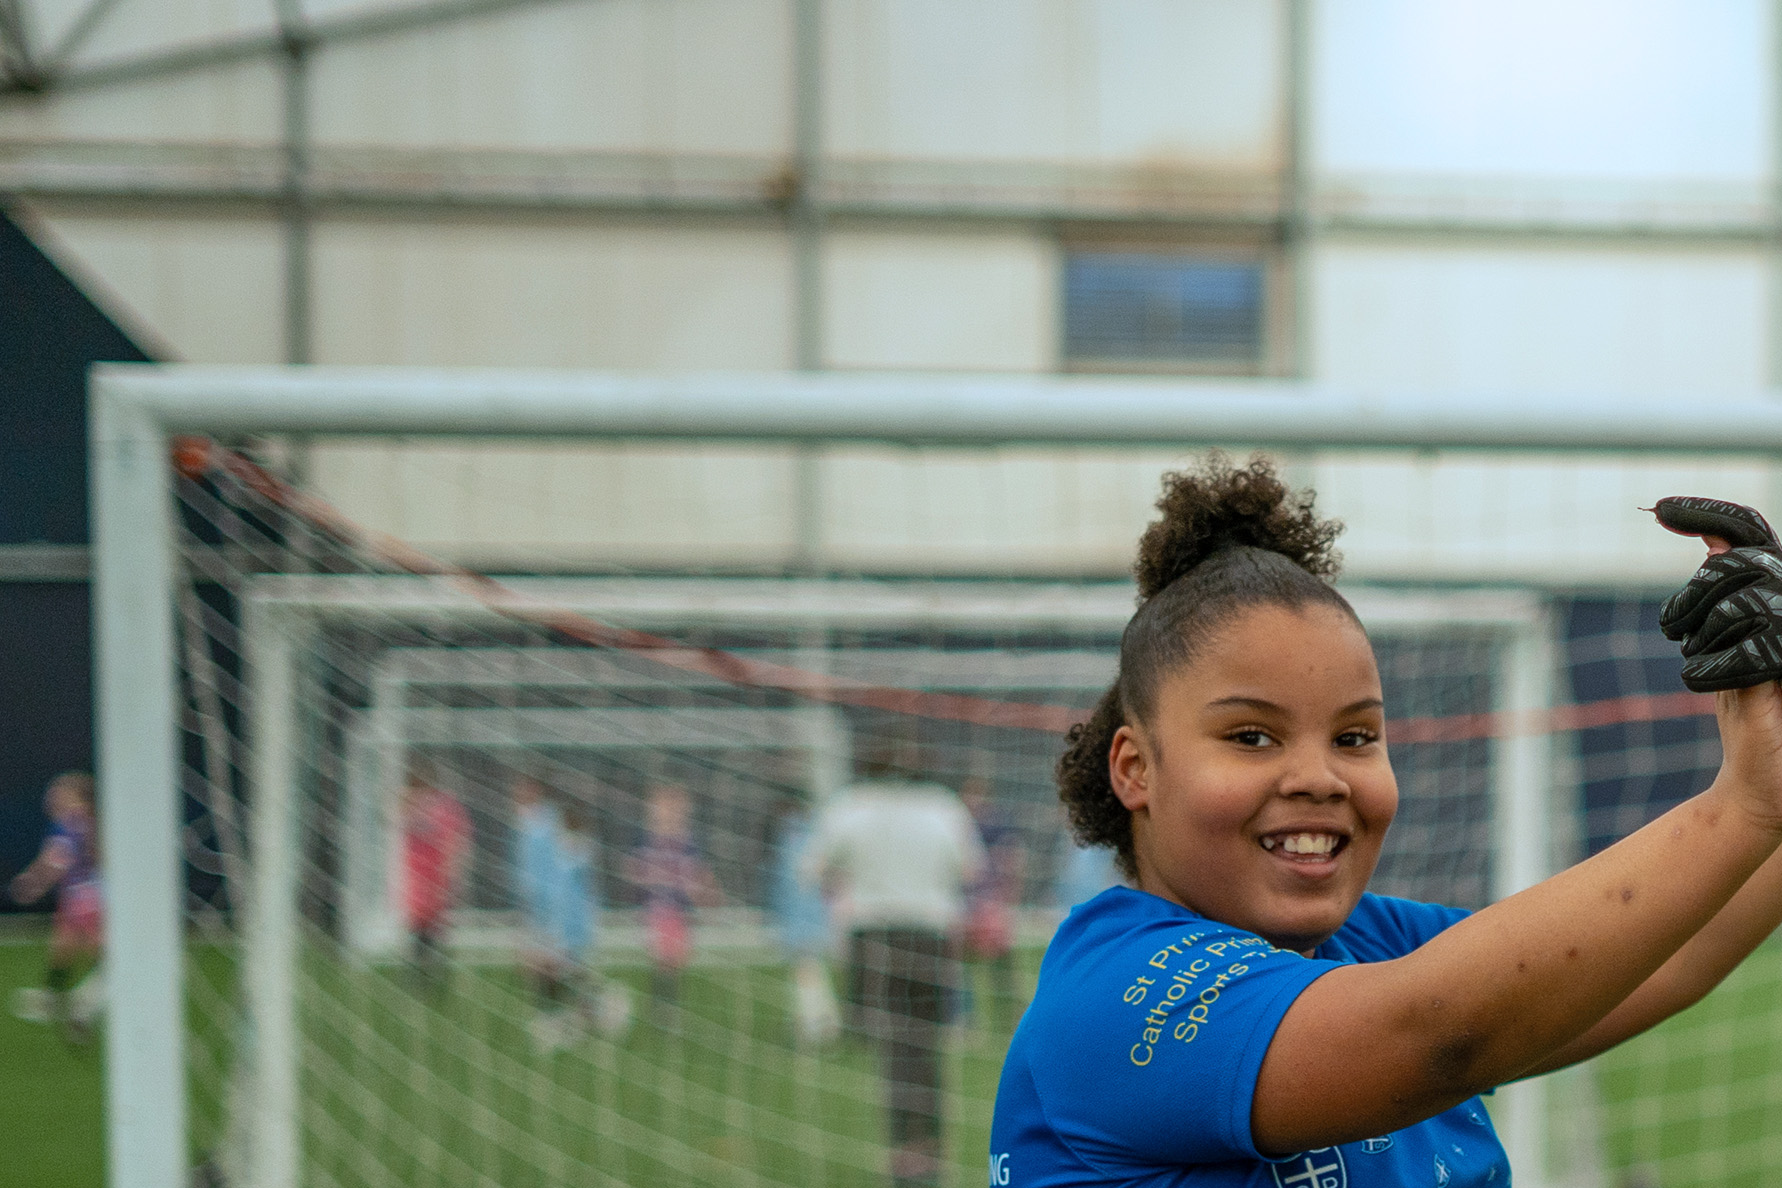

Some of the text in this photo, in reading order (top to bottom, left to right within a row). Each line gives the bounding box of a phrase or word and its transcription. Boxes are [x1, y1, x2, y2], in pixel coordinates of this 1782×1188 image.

[1123, 975, 1156, 1006] St
[1130, 959, 1211, 1067] Catholic
[1173, 962, 1249, 1043] Sports
